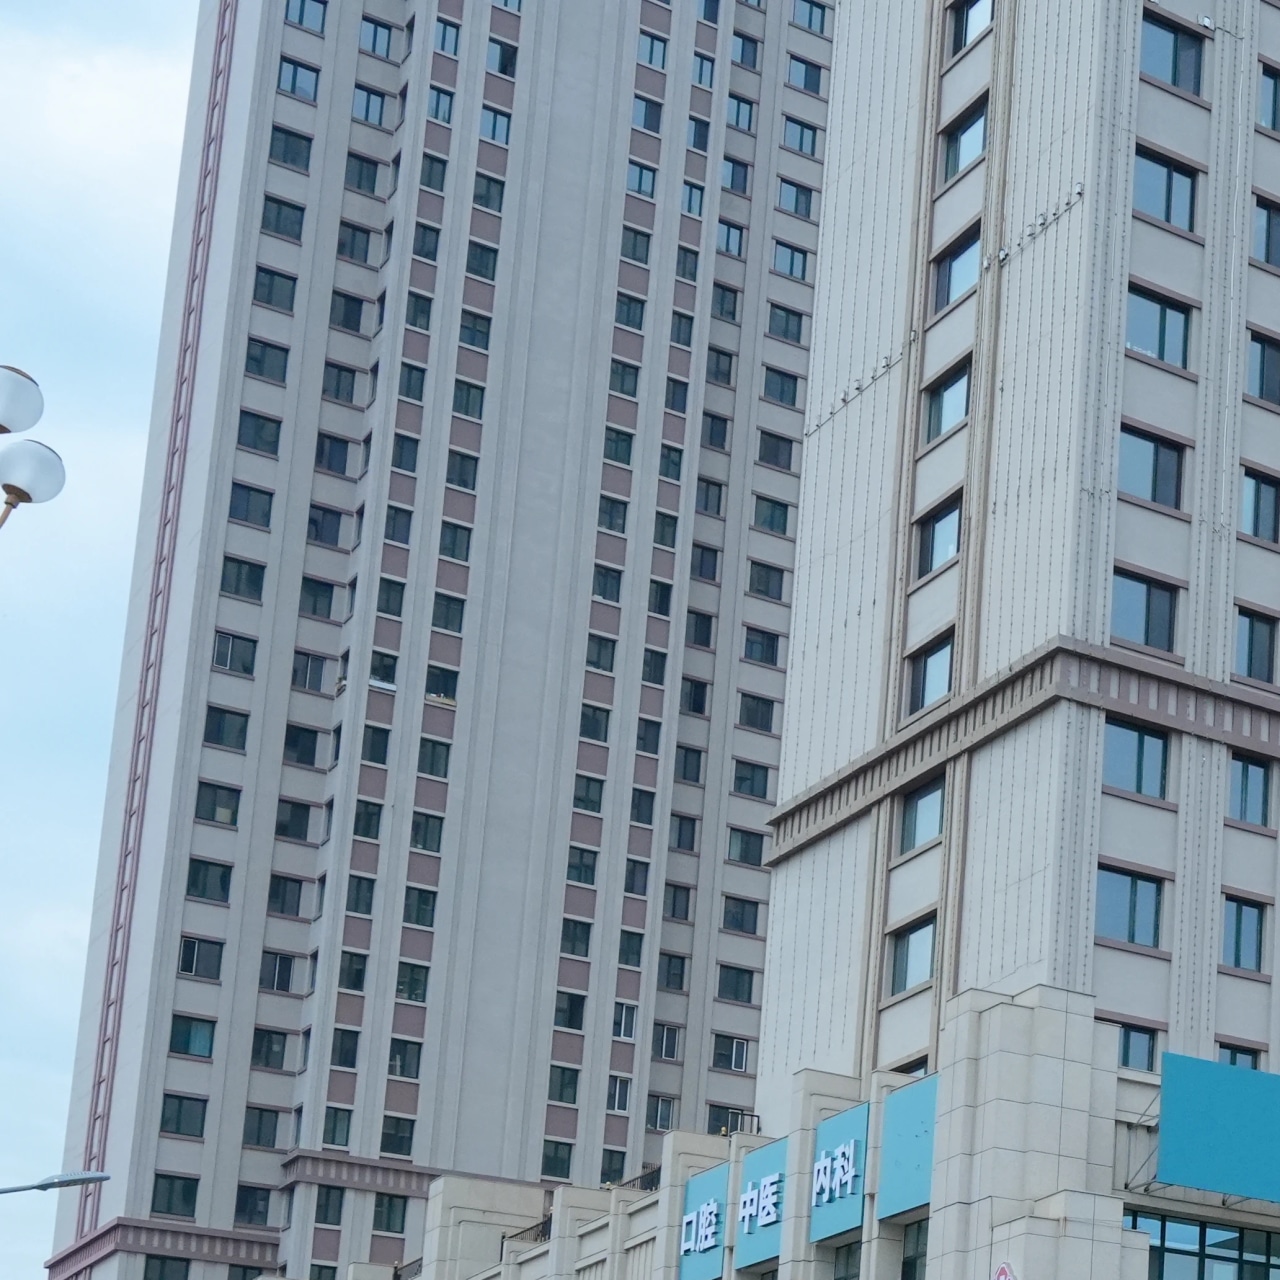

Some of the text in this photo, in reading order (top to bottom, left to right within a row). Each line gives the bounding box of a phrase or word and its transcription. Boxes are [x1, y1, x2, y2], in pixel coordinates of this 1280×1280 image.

[738, 1172, 780, 1234] 中医
[812, 1139, 858, 1207] 内科
[680, 1198, 719, 1255] 口腔
